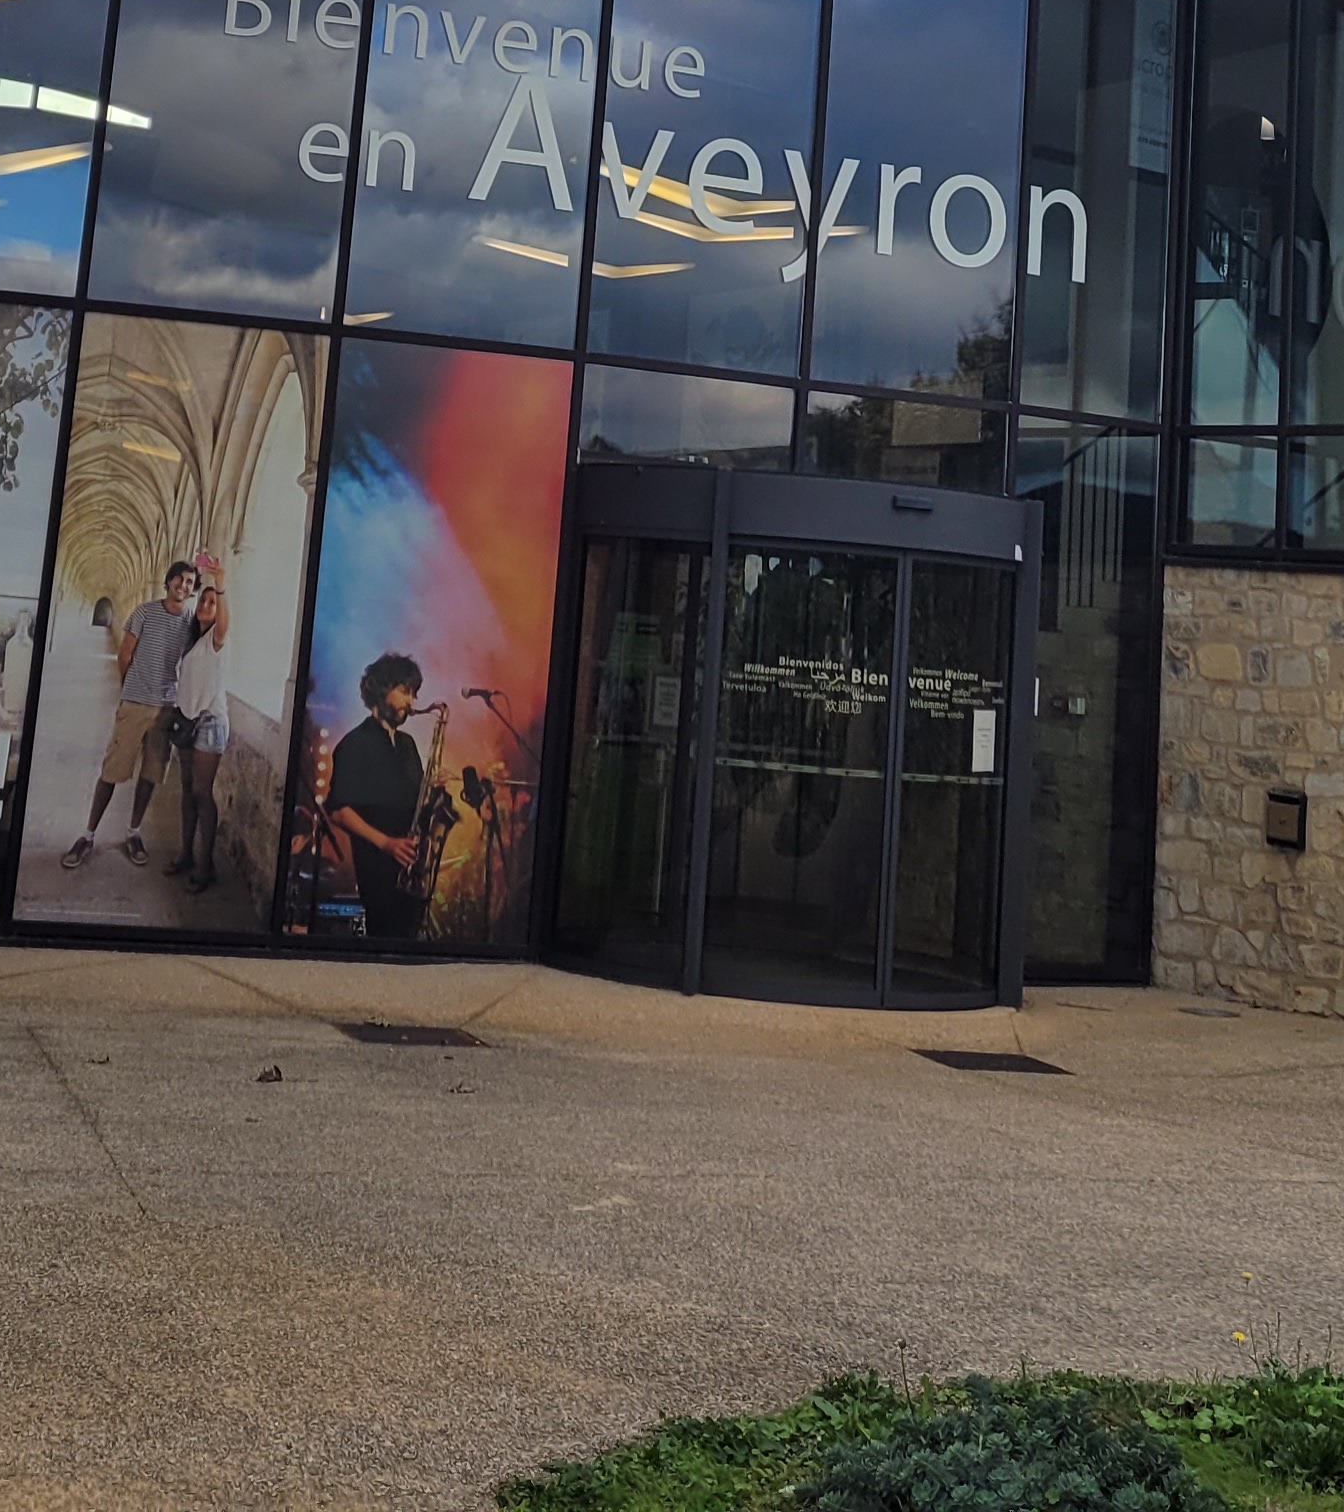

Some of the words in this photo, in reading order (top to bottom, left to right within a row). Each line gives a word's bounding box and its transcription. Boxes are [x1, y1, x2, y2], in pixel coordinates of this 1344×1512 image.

[298, 122, 416, 193] en
[468, 74, 1088, 285] Aveyron
[744, 662, 796, 677] Willkommen
[779, 656, 844, 670] Bienvenidos
[851, 668, 889, 686] Bien
[908, 676, 952, 691] venue
[945, 669, 978, 681] Welcome
[722, 681, 767, 693] Tervetuloa
[851, 688, 886, 703] Welkom
[909, 697, 949, 710] Velkommen
